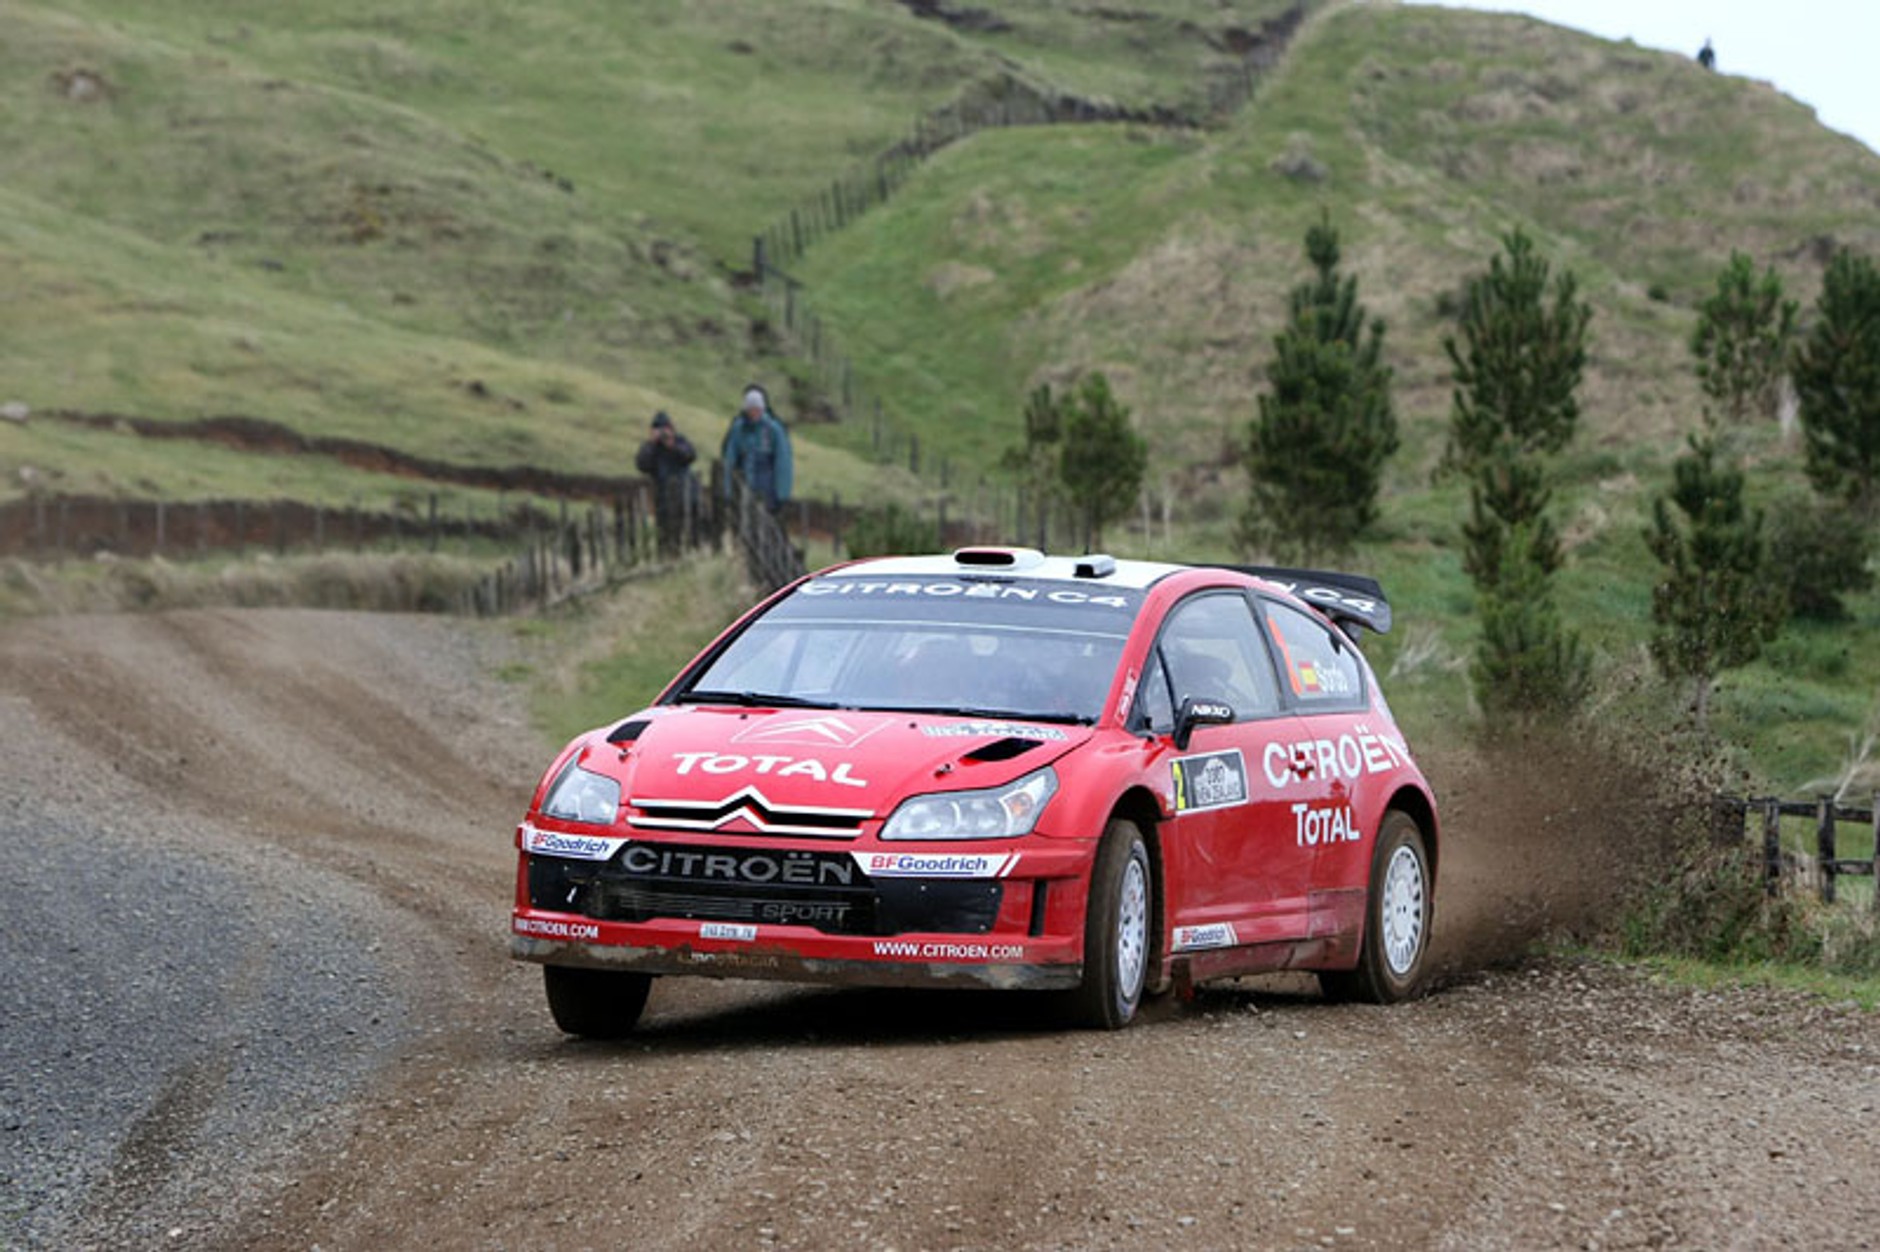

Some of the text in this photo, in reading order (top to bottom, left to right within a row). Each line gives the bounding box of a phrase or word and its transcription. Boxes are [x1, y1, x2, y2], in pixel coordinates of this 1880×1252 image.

[1047, 590, 1128, 607] C4
[1304, 587, 1376, 612] C4
[1263, 724, 1413, 788] CITROËN
[673, 752, 869, 788] TOTAL
[1172, 761, 1187, 810] 2
[1291, 803, 1360, 847] TOTAL
[532, 832, 610, 853] BFGoodrich
[622, 846, 853, 886] CITROËN
[870, 855, 988, 872] BFGoodrich
[762, 902, 851, 921] SPORT
[873, 941, 1024, 958] WWW.CITROEN.COM
